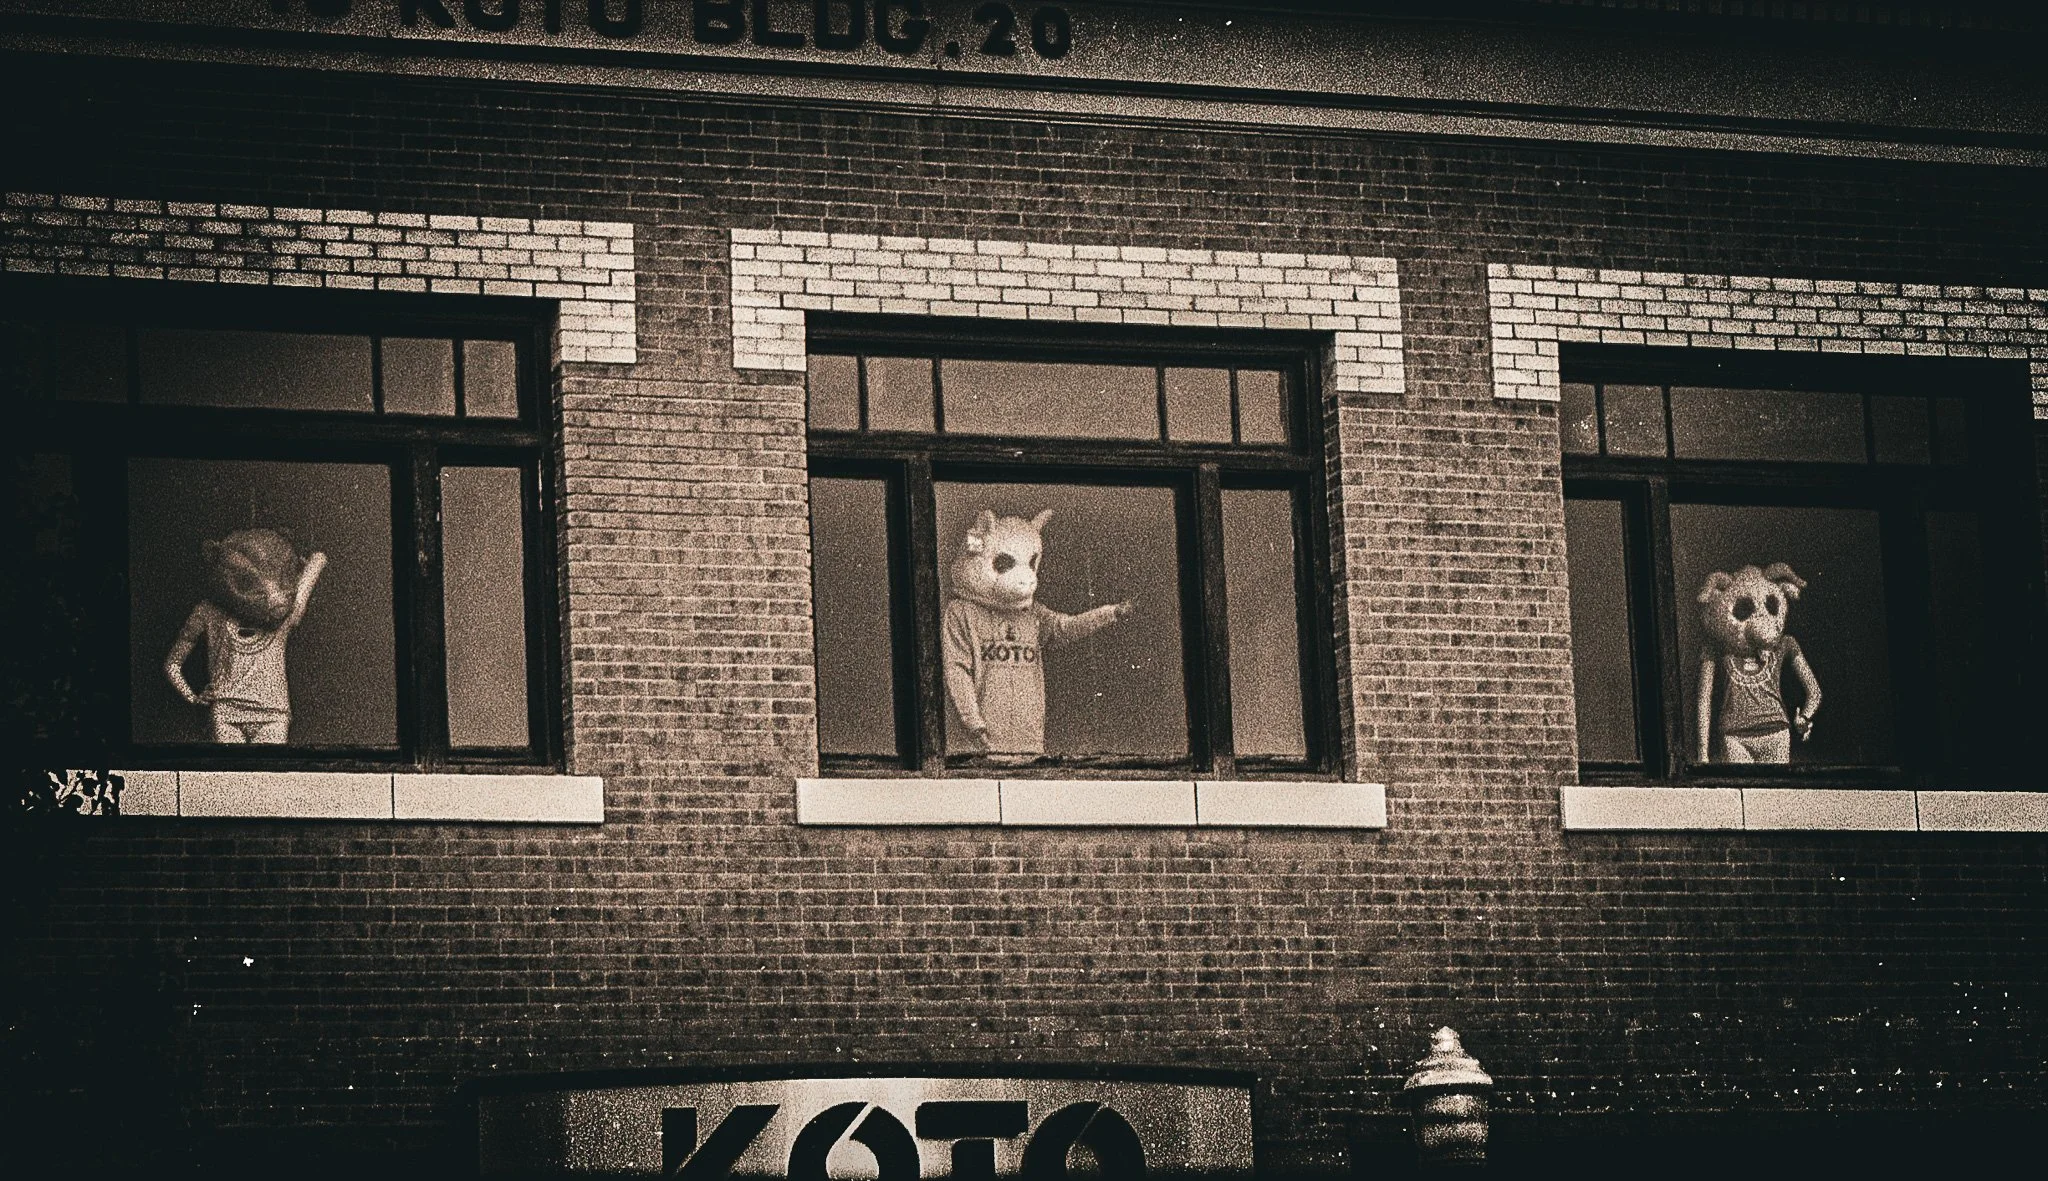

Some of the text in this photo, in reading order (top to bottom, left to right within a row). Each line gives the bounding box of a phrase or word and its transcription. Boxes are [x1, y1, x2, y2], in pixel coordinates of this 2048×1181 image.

[974, 1, 1071, 59] 20
[980, 643, 1035, 663] KOTO
[661, 1101, 1147, 1181] KOTO
